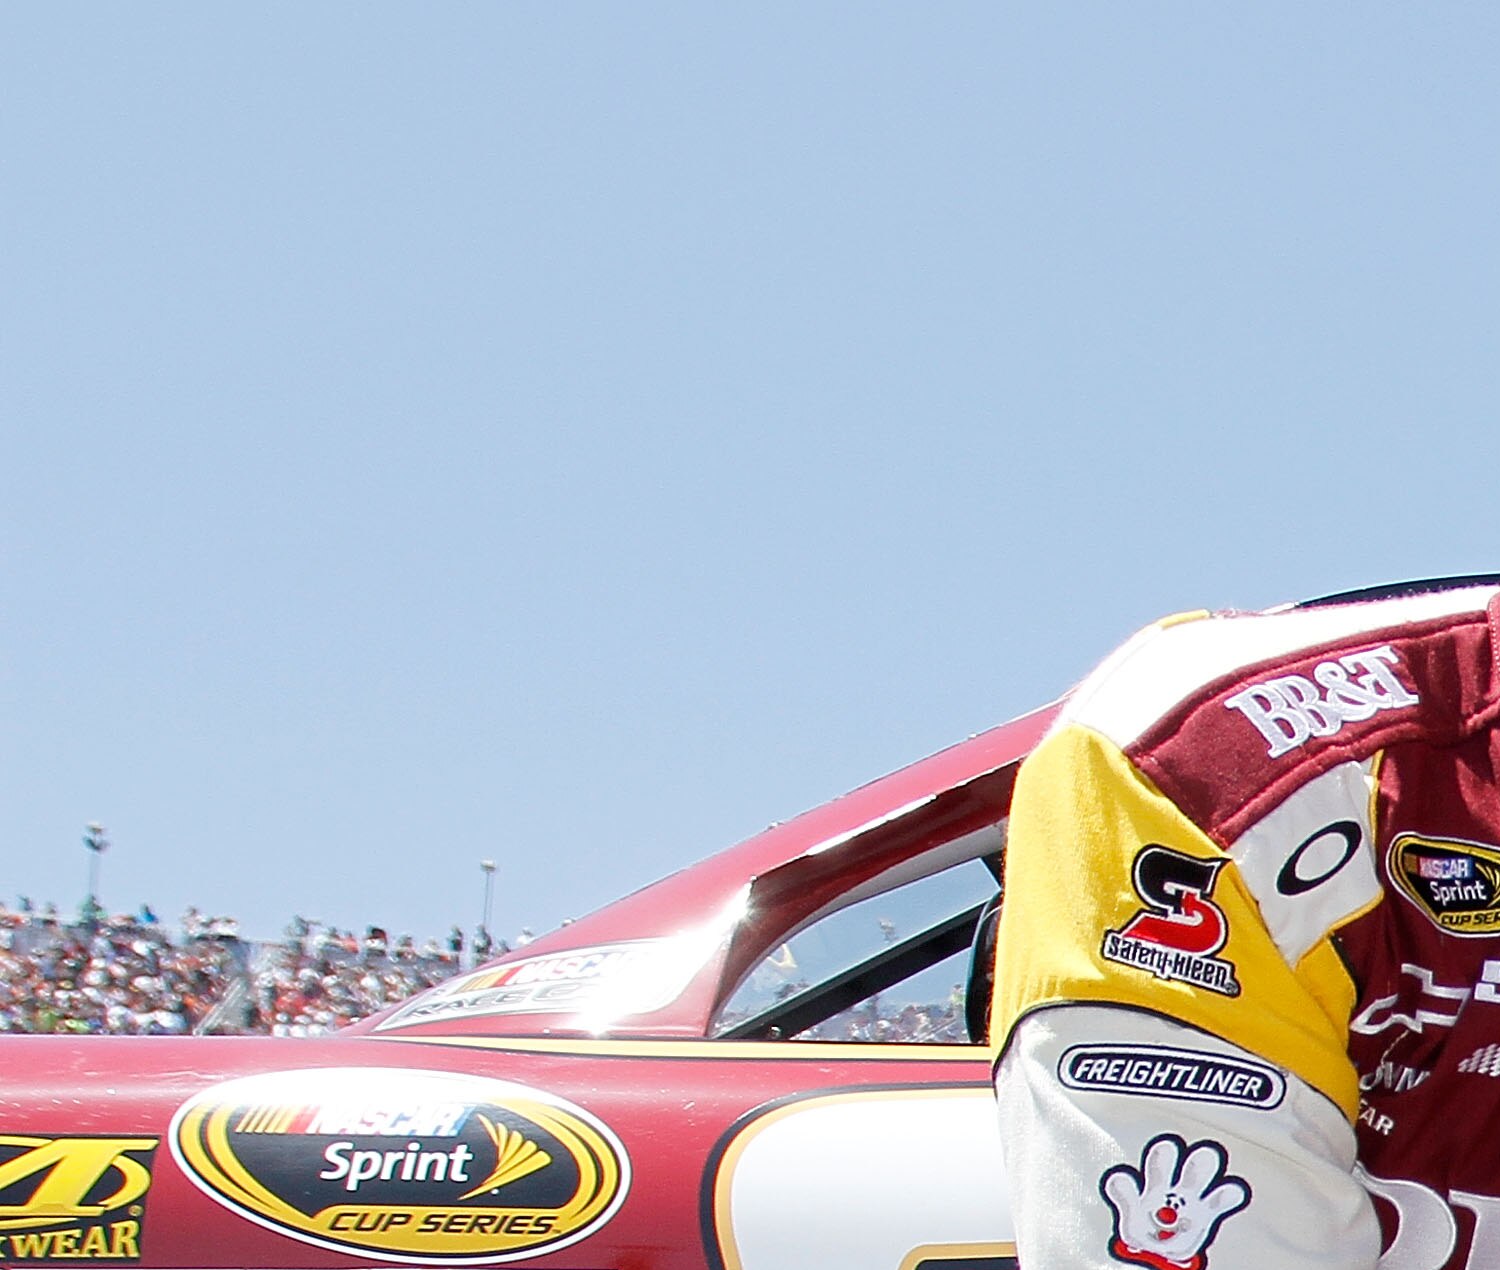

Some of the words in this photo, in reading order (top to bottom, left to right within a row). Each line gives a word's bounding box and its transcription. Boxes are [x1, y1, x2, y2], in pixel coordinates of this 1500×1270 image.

[1225, 645, 1420, 759] BB&T
[1429, 880, 1487, 907] Sprint
[1440, 913, 1472, 926] CUP
[1075, 1058, 1263, 1098] FREIGHTLINER
[319, 1141, 473, 1191] Sprint
[328, 1211, 412, 1234] CUP
[417, 1212, 556, 1236] SERIES
